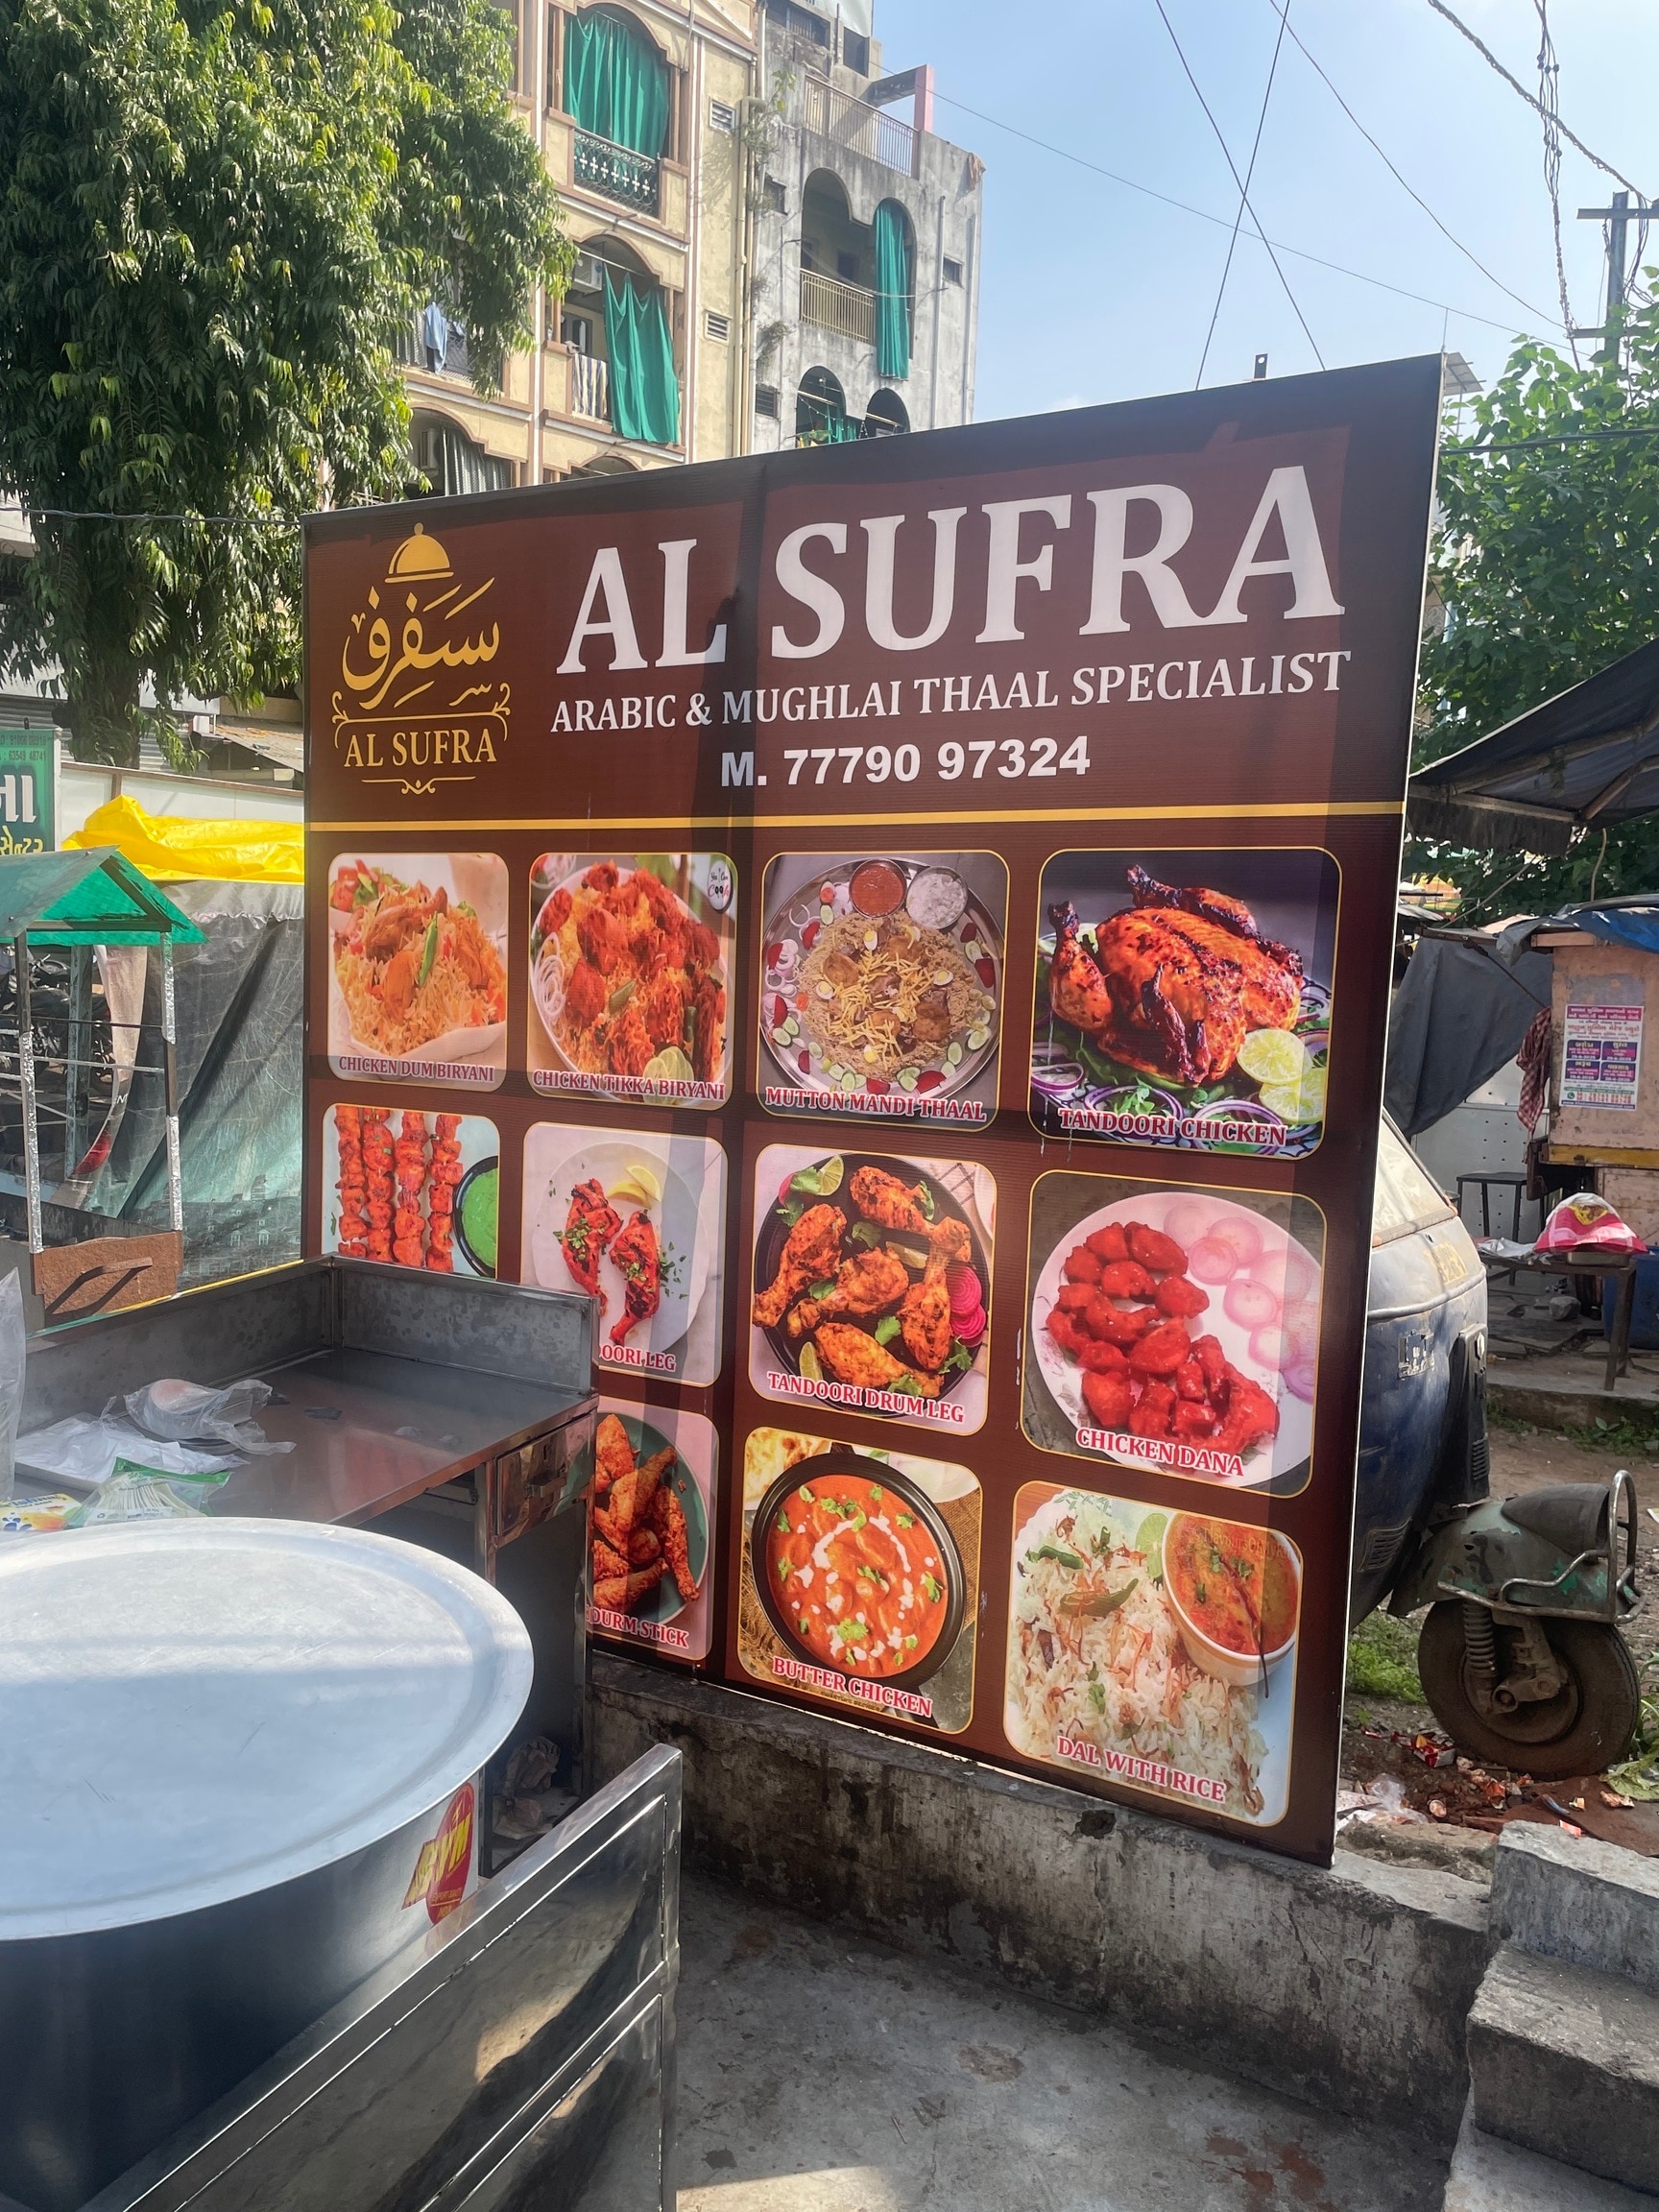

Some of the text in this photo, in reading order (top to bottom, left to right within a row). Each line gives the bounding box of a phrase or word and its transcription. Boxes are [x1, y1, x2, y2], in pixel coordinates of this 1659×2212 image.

[555, 465, 1346, 675] AL SUFRA
[549, 649, 1352, 733] ARABIC & MUGHLAI THAAL SPECIALIST
[343, 728, 497, 767] AL SUFRA
[720, 735, 1091, 787] M. 77790 97324
[338, 1055, 494, 1083] CHICKEN DUM BIRYANI
[533, 1070, 726, 1101] CHICKEN TIKKA BIRYANI
[765, 1087, 987, 1121] MUTTON MANDI THAAL
[1059, 1108, 1288, 1147] TANDOORI CHICKEN
[599, 1344, 676, 1372] OORI LEG
[768, 1371, 965, 1423] TANDOORI DRUM LEG
[1076, 1428, 1244, 1477] CHICKEN DANA
[589, 1607, 689, 1648] DURM STICK
[772, 1656, 846, 1694] BUTTER
[848, 1678, 933, 1718] CHICKEN
[1057, 1736, 1227, 1803] DAL WITH RICE
